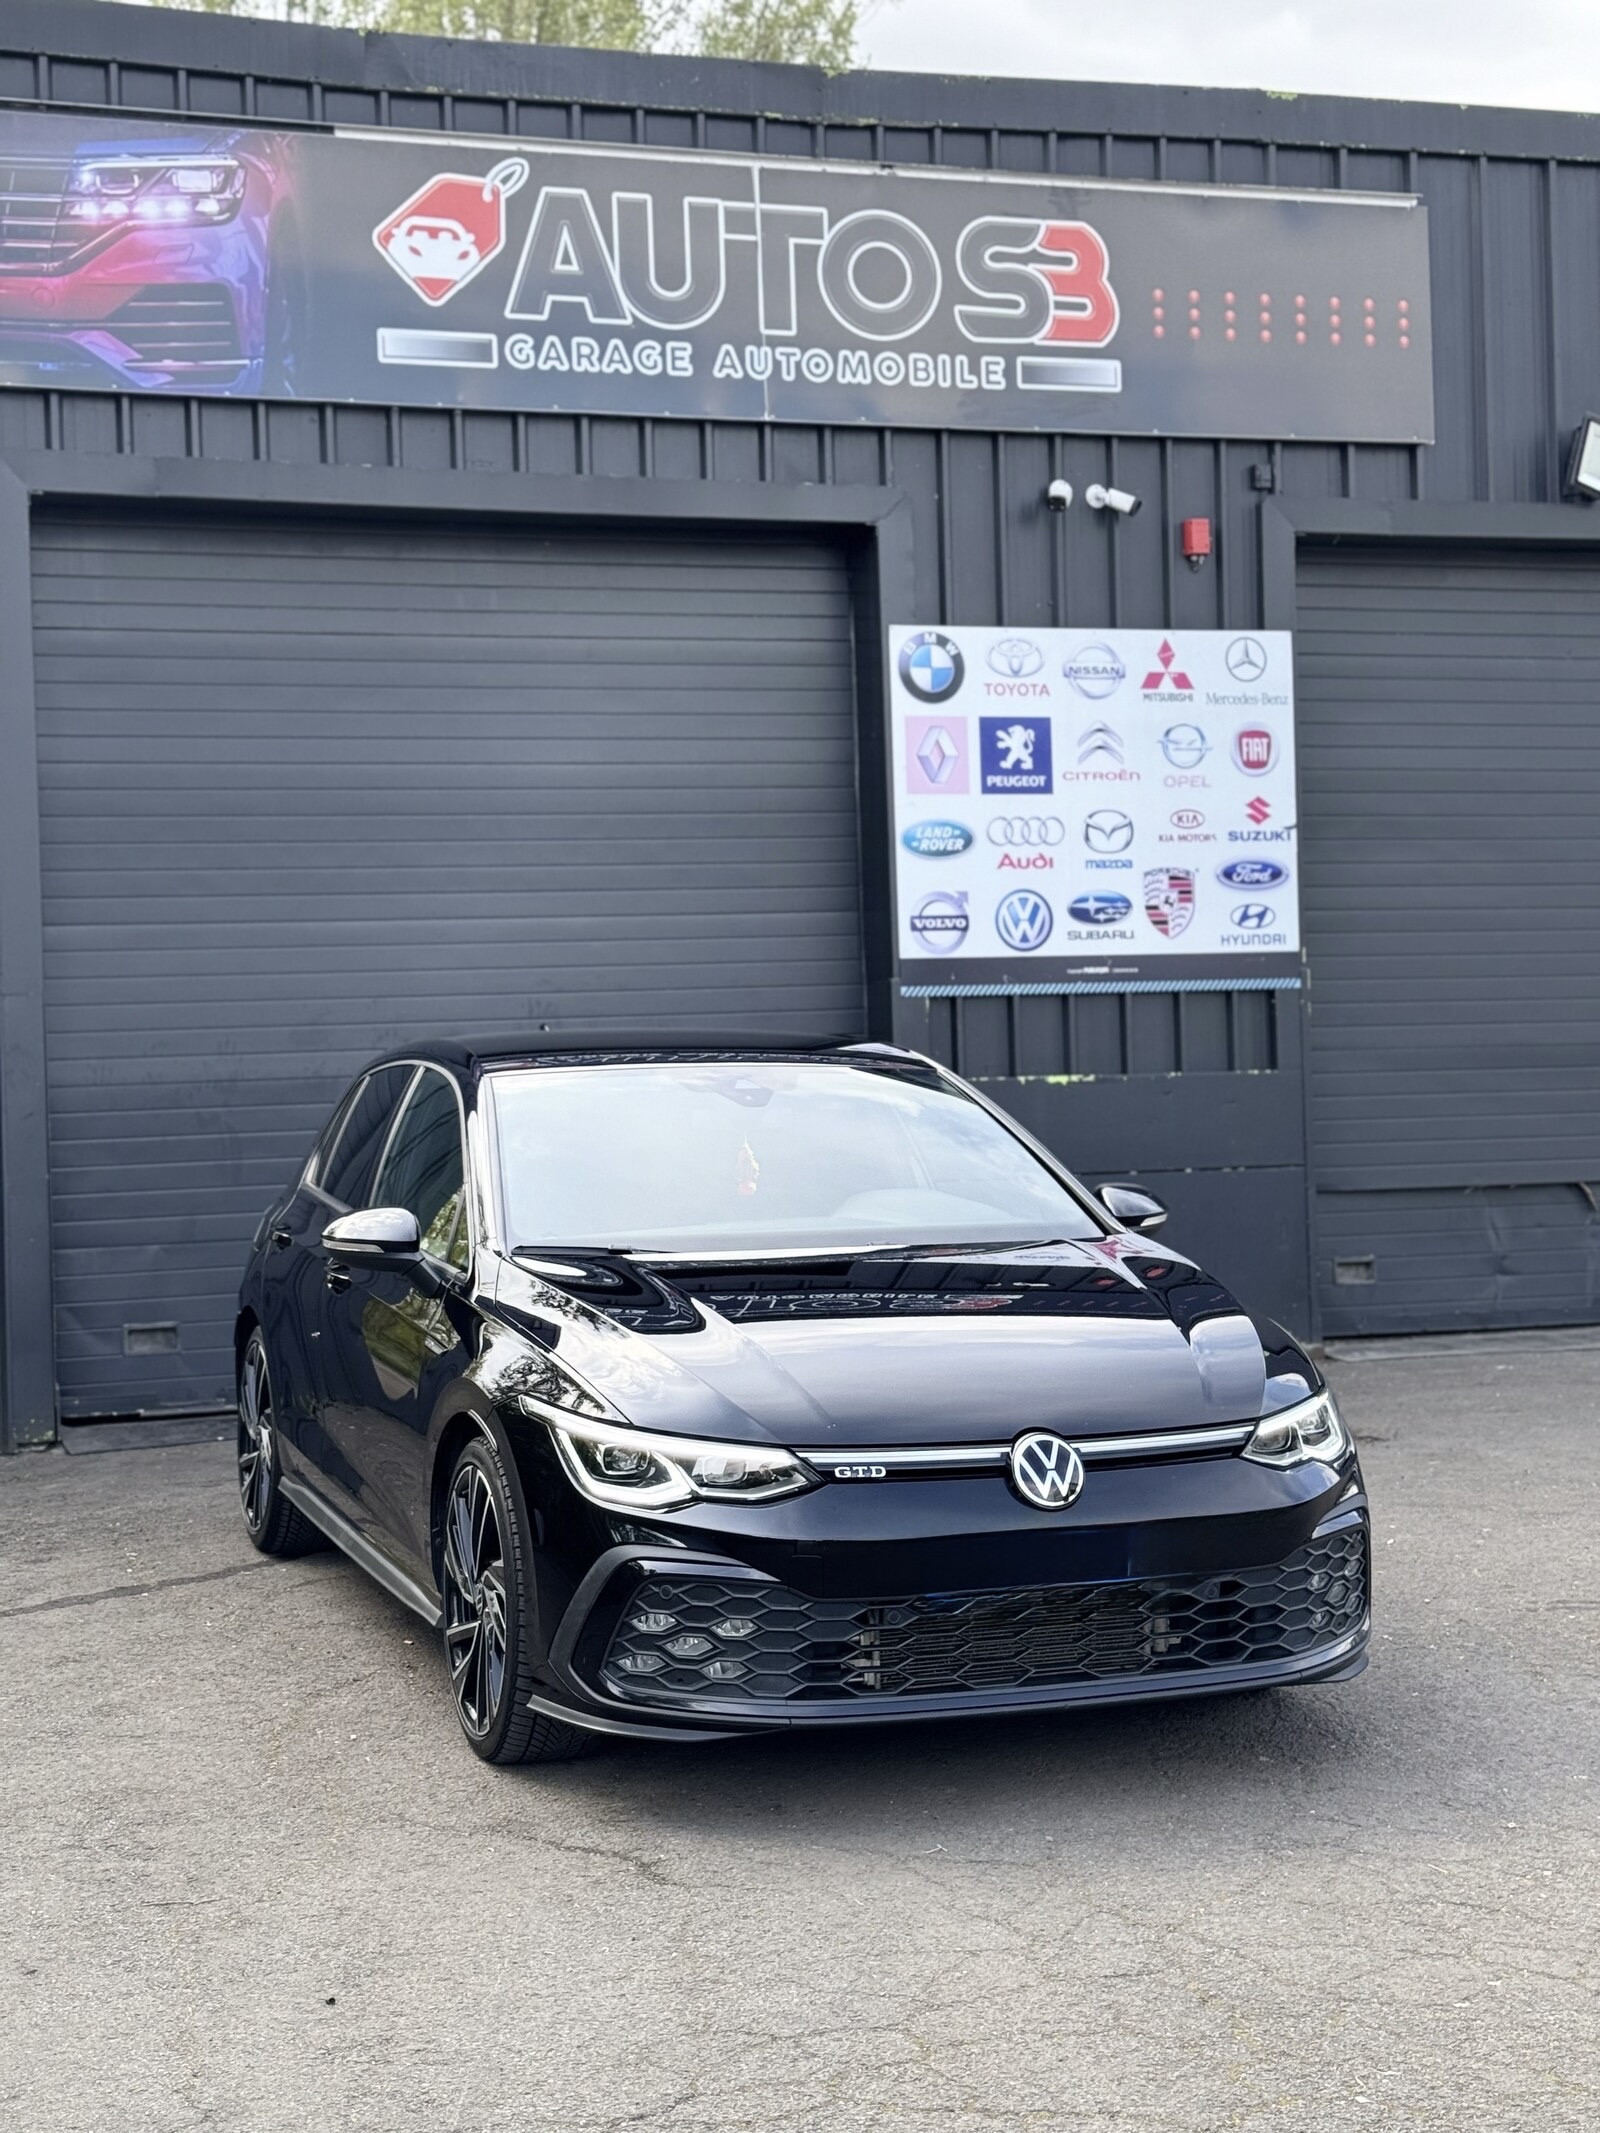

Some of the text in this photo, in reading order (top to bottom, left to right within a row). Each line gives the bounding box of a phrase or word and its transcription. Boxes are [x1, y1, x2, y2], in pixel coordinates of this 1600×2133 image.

[505, 186, 942, 341] AUTO
[504, 333, 1007, 391] GARAGE AUTOMOBILE
[903, 631, 960, 657] BMW
[1068, 666, 1120, 676] NISSAN
[984, 683, 1051, 697] TOYOTA
[1142, 692, 1194, 702] MITSUBISHI
[1205, 692, 1289, 706] Mercedes-Benz
[1241, 737, 1270, 763] FIAT
[986, 774, 1047, 788] PEUGEOT
[1163, 775, 1212, 788] OPEL
[1176, 814, 1201, 825] KIA
[1158, 834, 1175, 842] KIA
[1228, 830, 1292, 842] SUZUKI
[997, 853, 1055, 870] Audi
[1232, 863, 1273, 883] Ford
[912, 917, 968, 930] VOLVO
[1066, 930, 1135, 941] SUBARU
[1221, 933, 1288, 945] HYUNDAI
[834, 1465, 887, 1479] GTD
